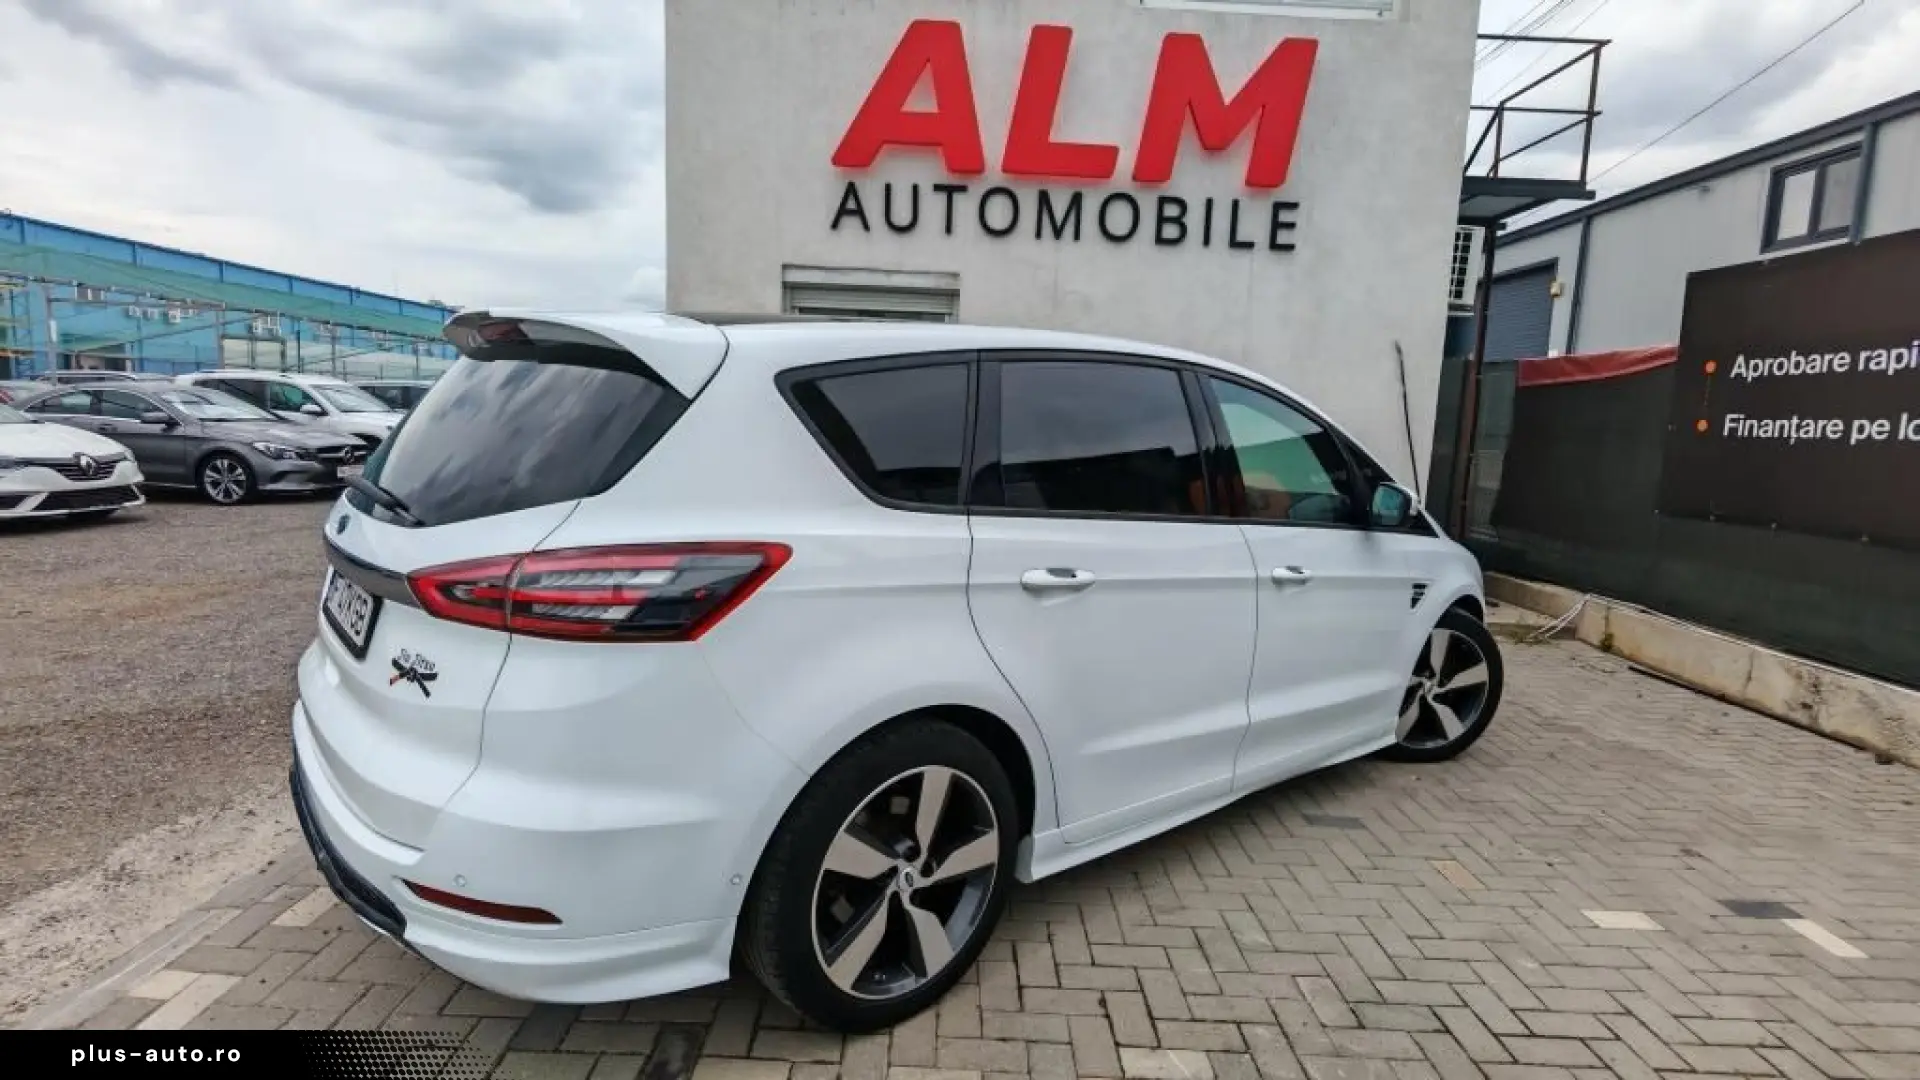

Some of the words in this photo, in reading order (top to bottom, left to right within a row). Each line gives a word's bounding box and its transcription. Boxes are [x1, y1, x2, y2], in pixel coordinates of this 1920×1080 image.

[831, 19, 1319, 188] ALM
[831, 180, 1299, 251] AUTOMOBILE
[1730, 350, 1851, 382] Aprobare
[1723, 413, 1844, 445] Finanțare
[1850, 419, 1891, 445] pe
